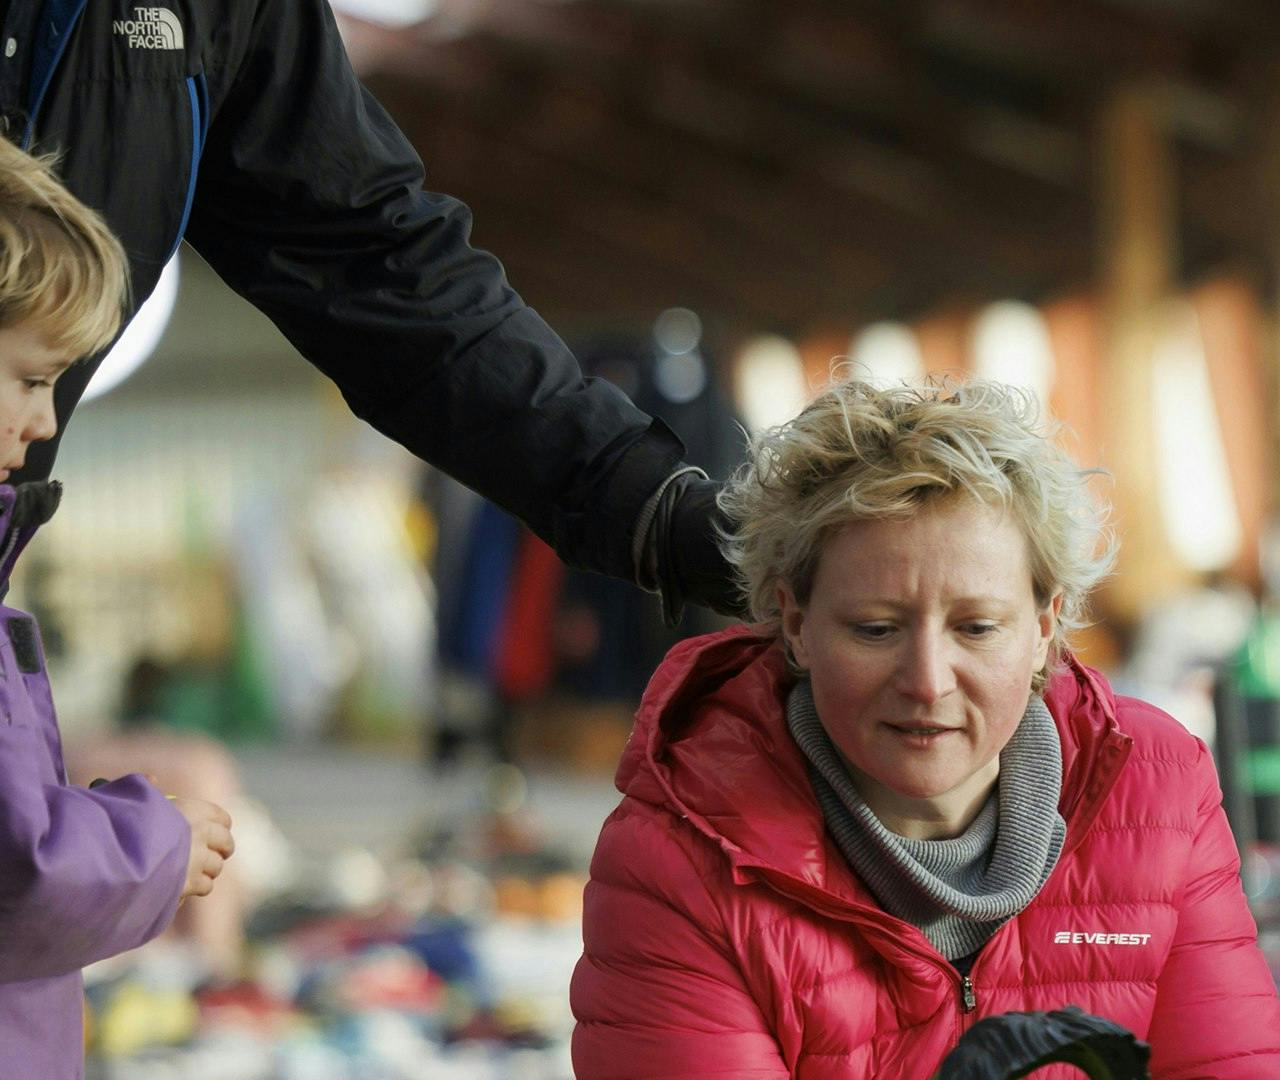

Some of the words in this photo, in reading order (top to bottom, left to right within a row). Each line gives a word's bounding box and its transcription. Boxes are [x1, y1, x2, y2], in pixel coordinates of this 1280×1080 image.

[134, 7, 161, 22] THE
[113, 20, 161, 35] NORTH
[129, 35, 163, 49] FACE
[1072, 932, 1151, 945] EVEREST
